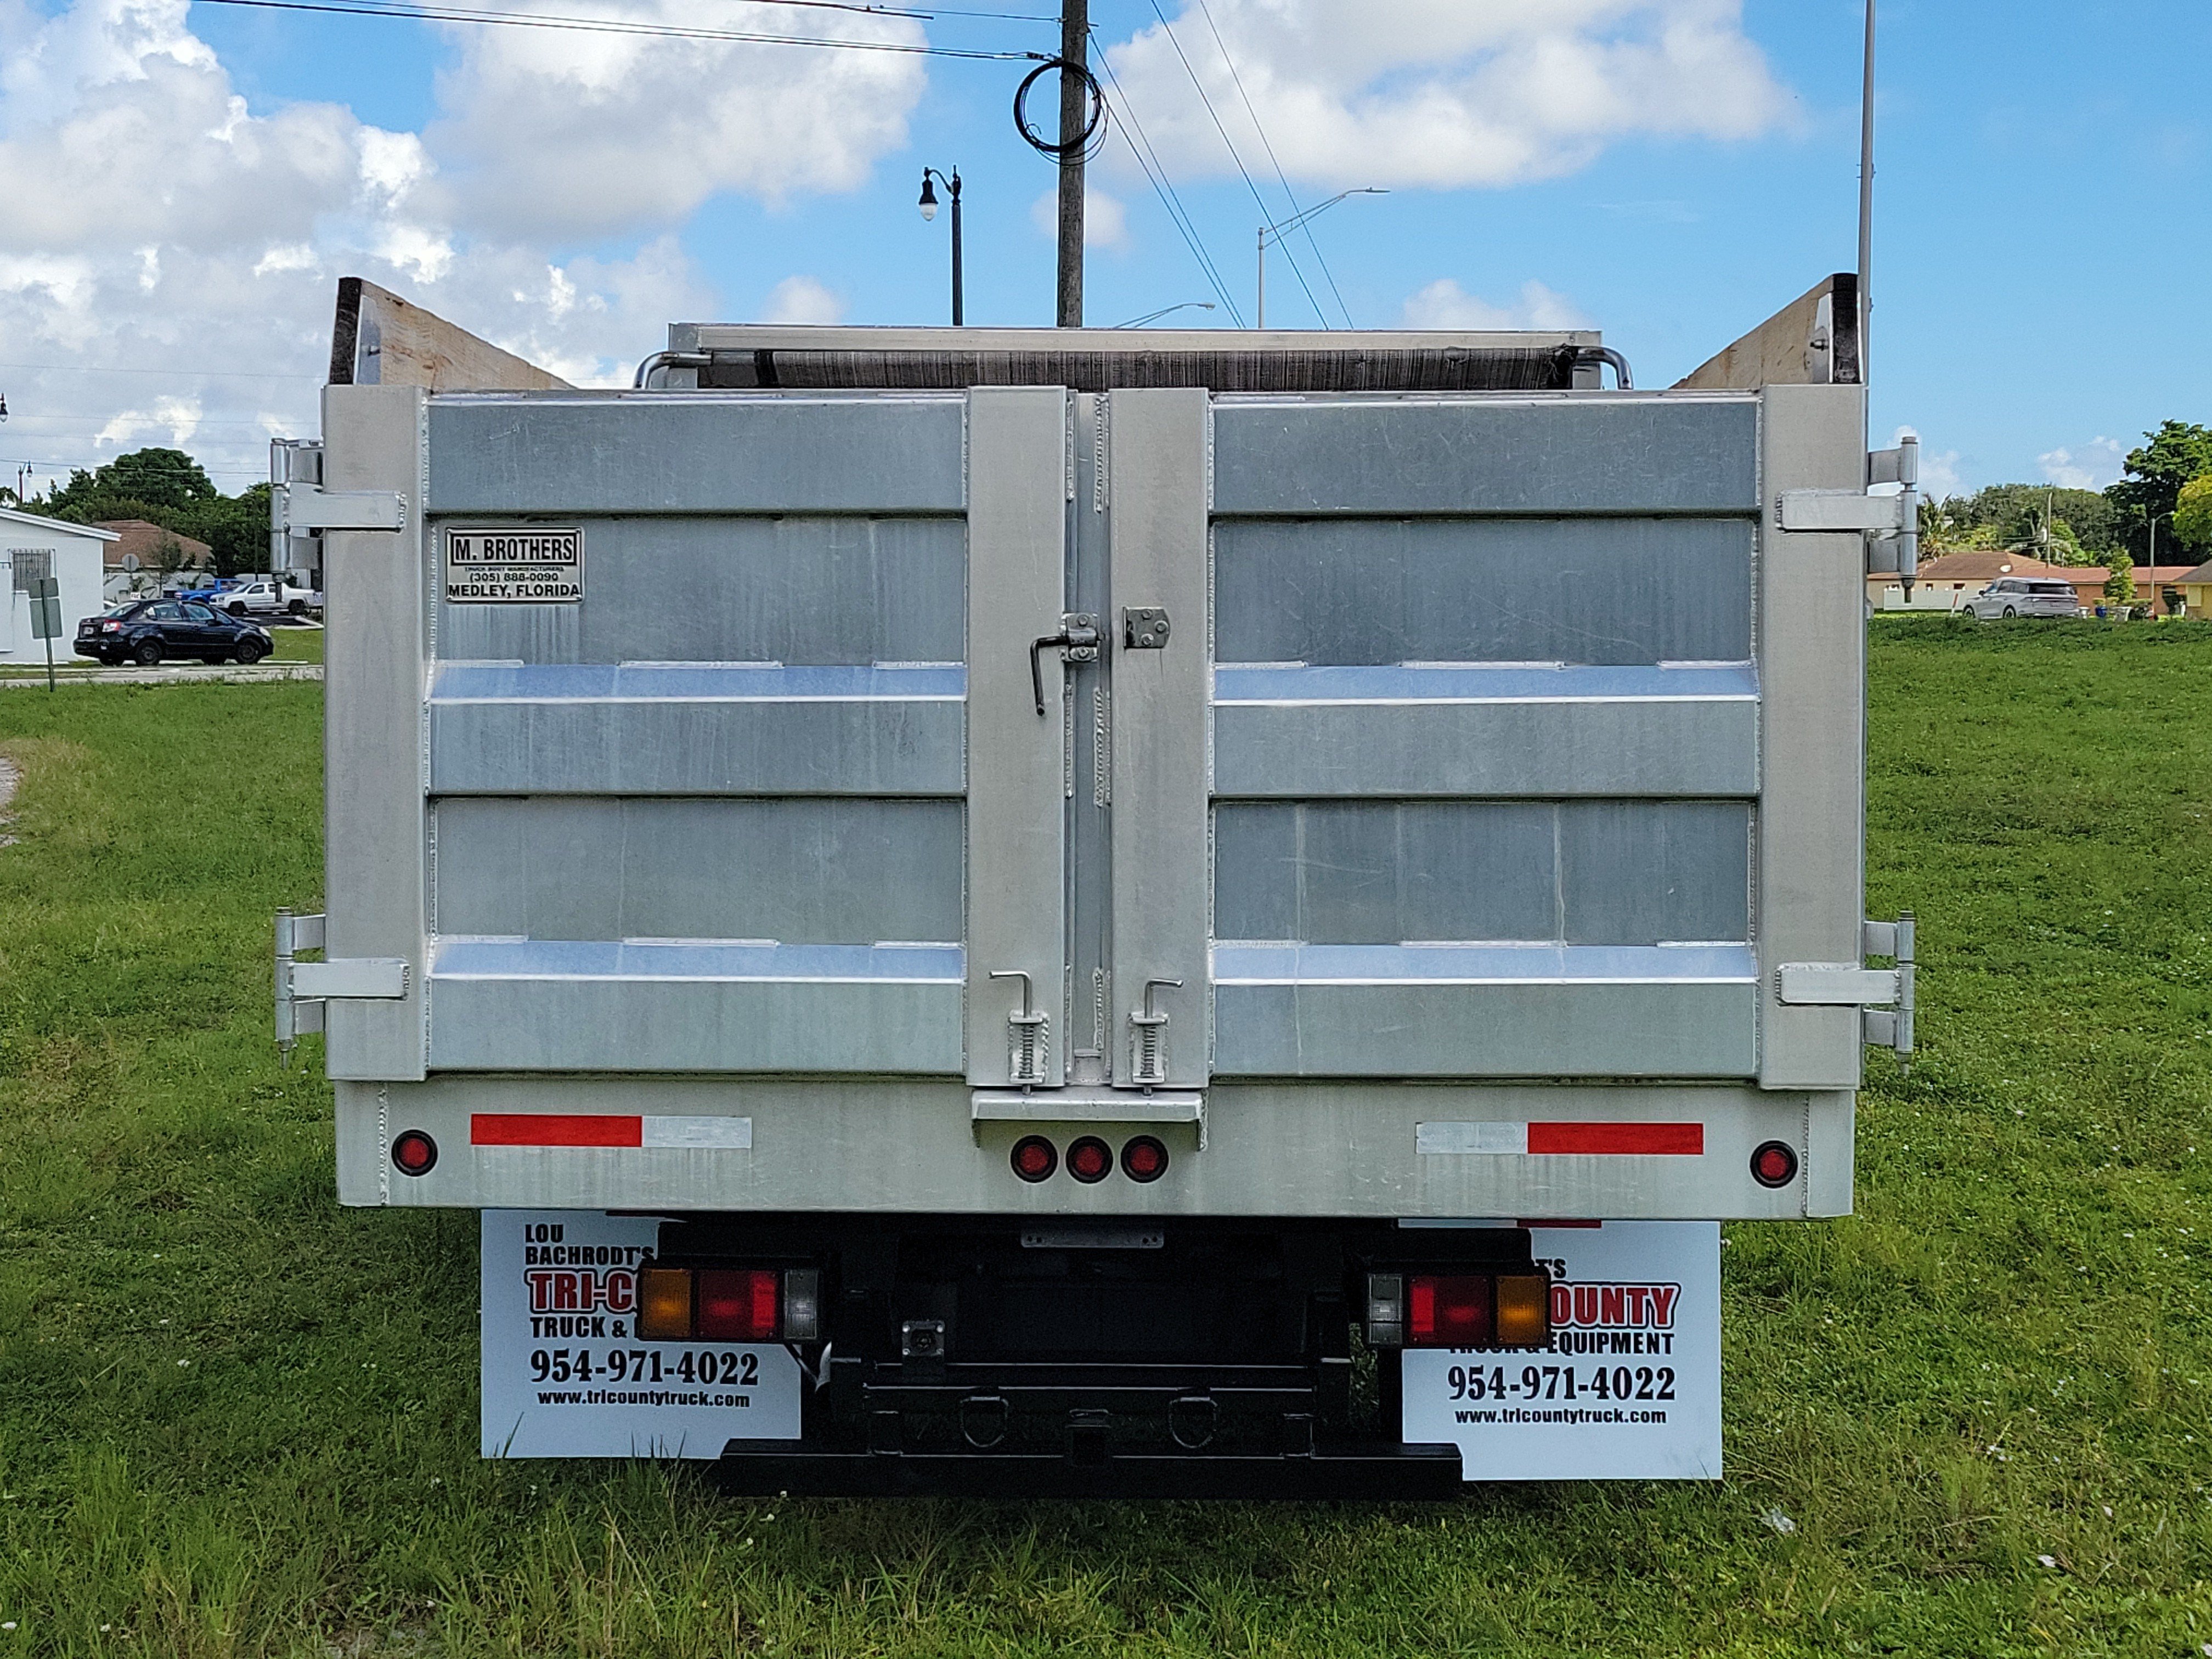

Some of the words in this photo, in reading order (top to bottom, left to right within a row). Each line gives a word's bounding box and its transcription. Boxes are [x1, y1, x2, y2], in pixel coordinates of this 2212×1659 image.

[455, 538, 477, 561] M.
[483, 538, 573, 561] BROTHERS
[470, 572, 500, 583] (305)
[504, 572, 559, 582] 888-0090
[448, 584, 511, 599] MEDLEY,
[516, 584, 580, 596] FLORIDA
[525, 1224, 563, 1243] LOU
[525, 1246, 654, 1265] BACHRODT'S
[528, 1271, 633, 1311] TRI-C
[1550, 1285, 1675, 1325] OUNTY
[530, 1317, 605, 1338] TRUCK
[611, 1320, 627, 1338] &
[1547, 1331, 1675, 1356] EQUIPMENT
[530, 1347, 759, 1386] 954-971-4022
[1447, 1364, 1675, 1401] 954-971-4022
[537, 1389, 750, 1407] www.tricountytruck.com
[1454, 1408, 1667, 1425] www.tricountytruck.com
